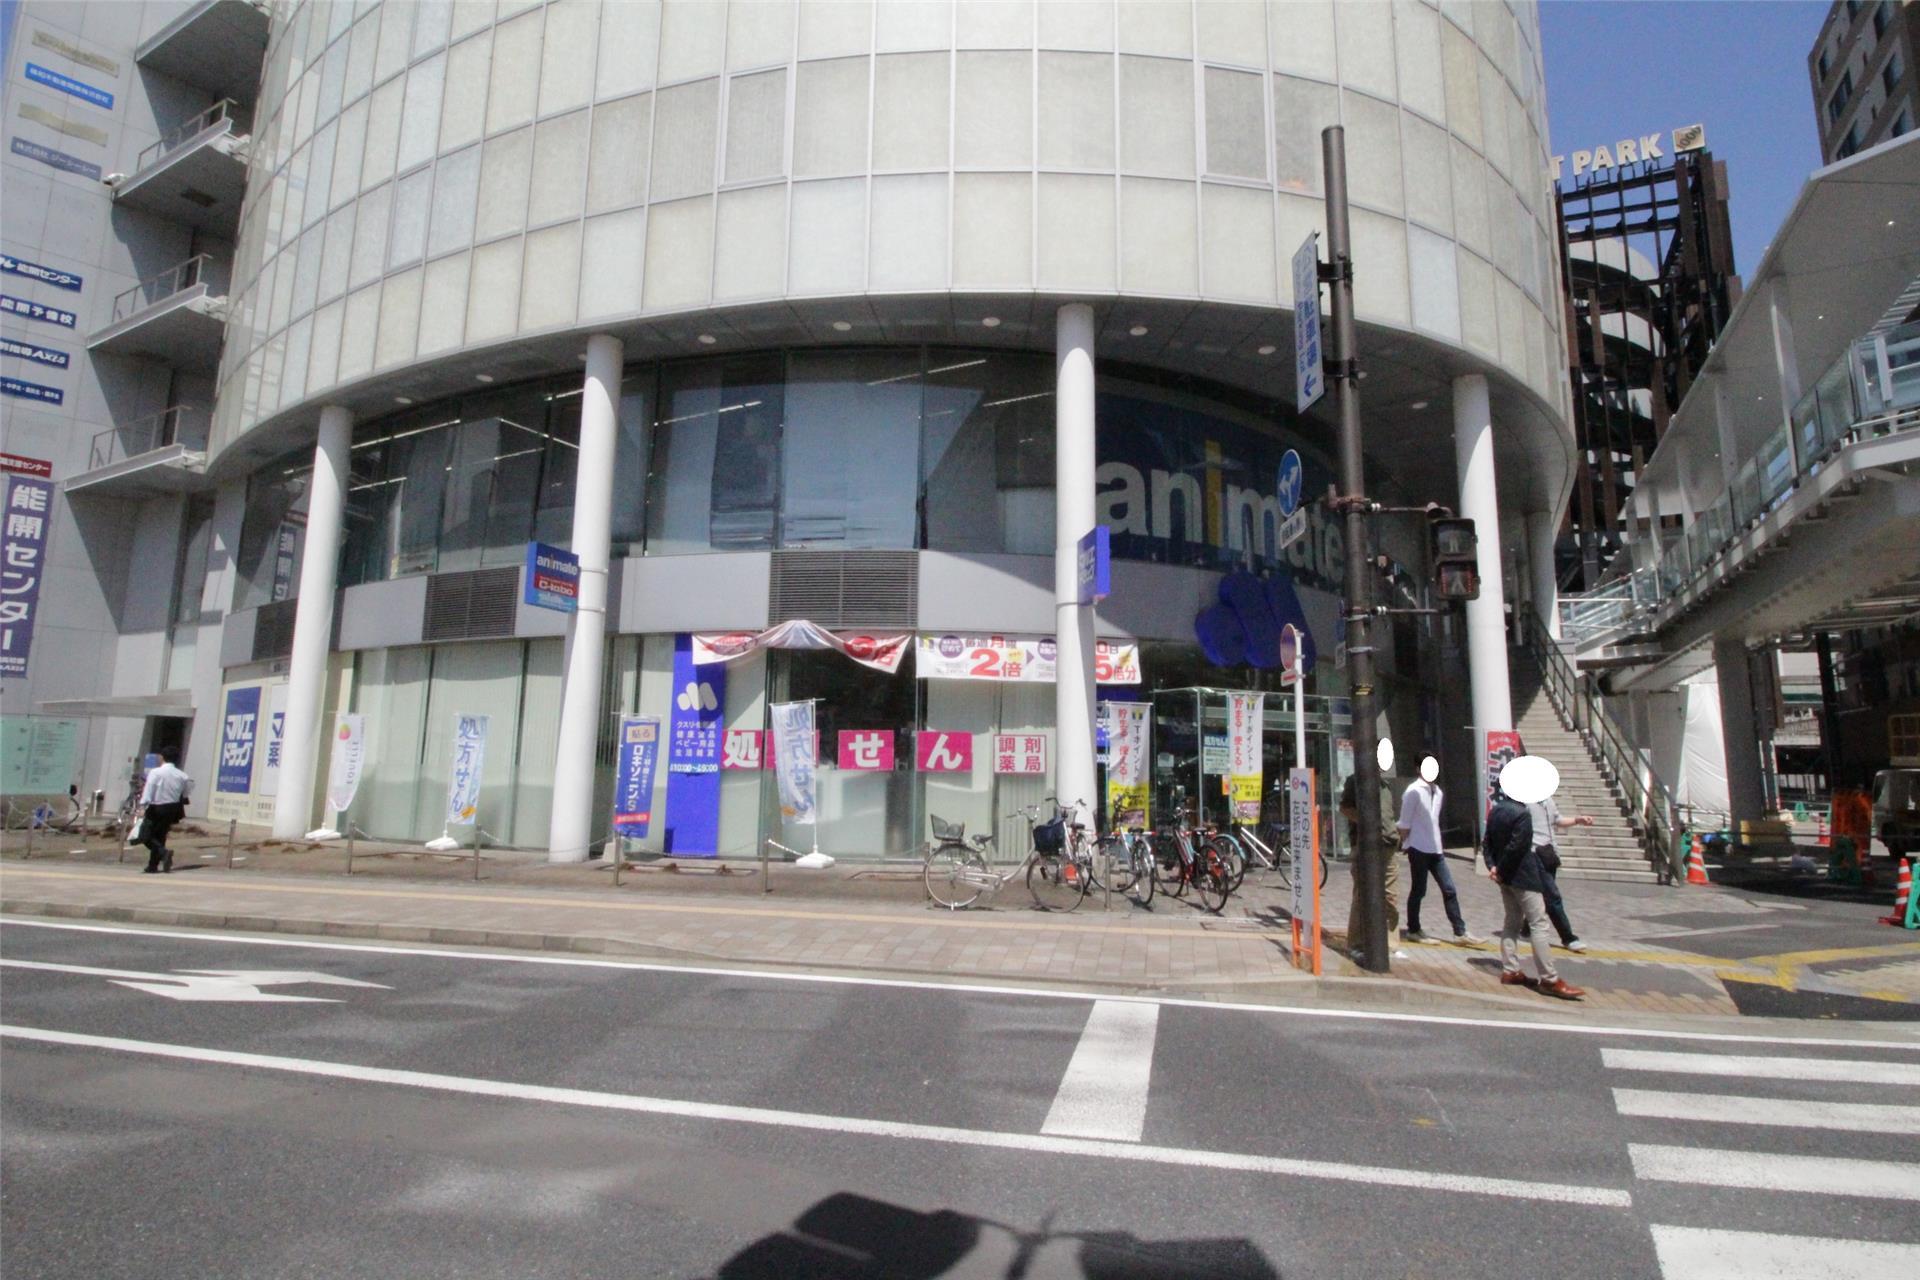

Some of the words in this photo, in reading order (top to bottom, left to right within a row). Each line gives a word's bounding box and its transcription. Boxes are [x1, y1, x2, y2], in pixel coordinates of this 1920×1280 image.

[1572, 133, 1664, 176] PARK
[0, 484, 47, 650] 能開センター
[537, 555, 578, 576] animate
[999, 736, 1041, 753] 調剤
[999, 755, 1041, 771] 薬局
